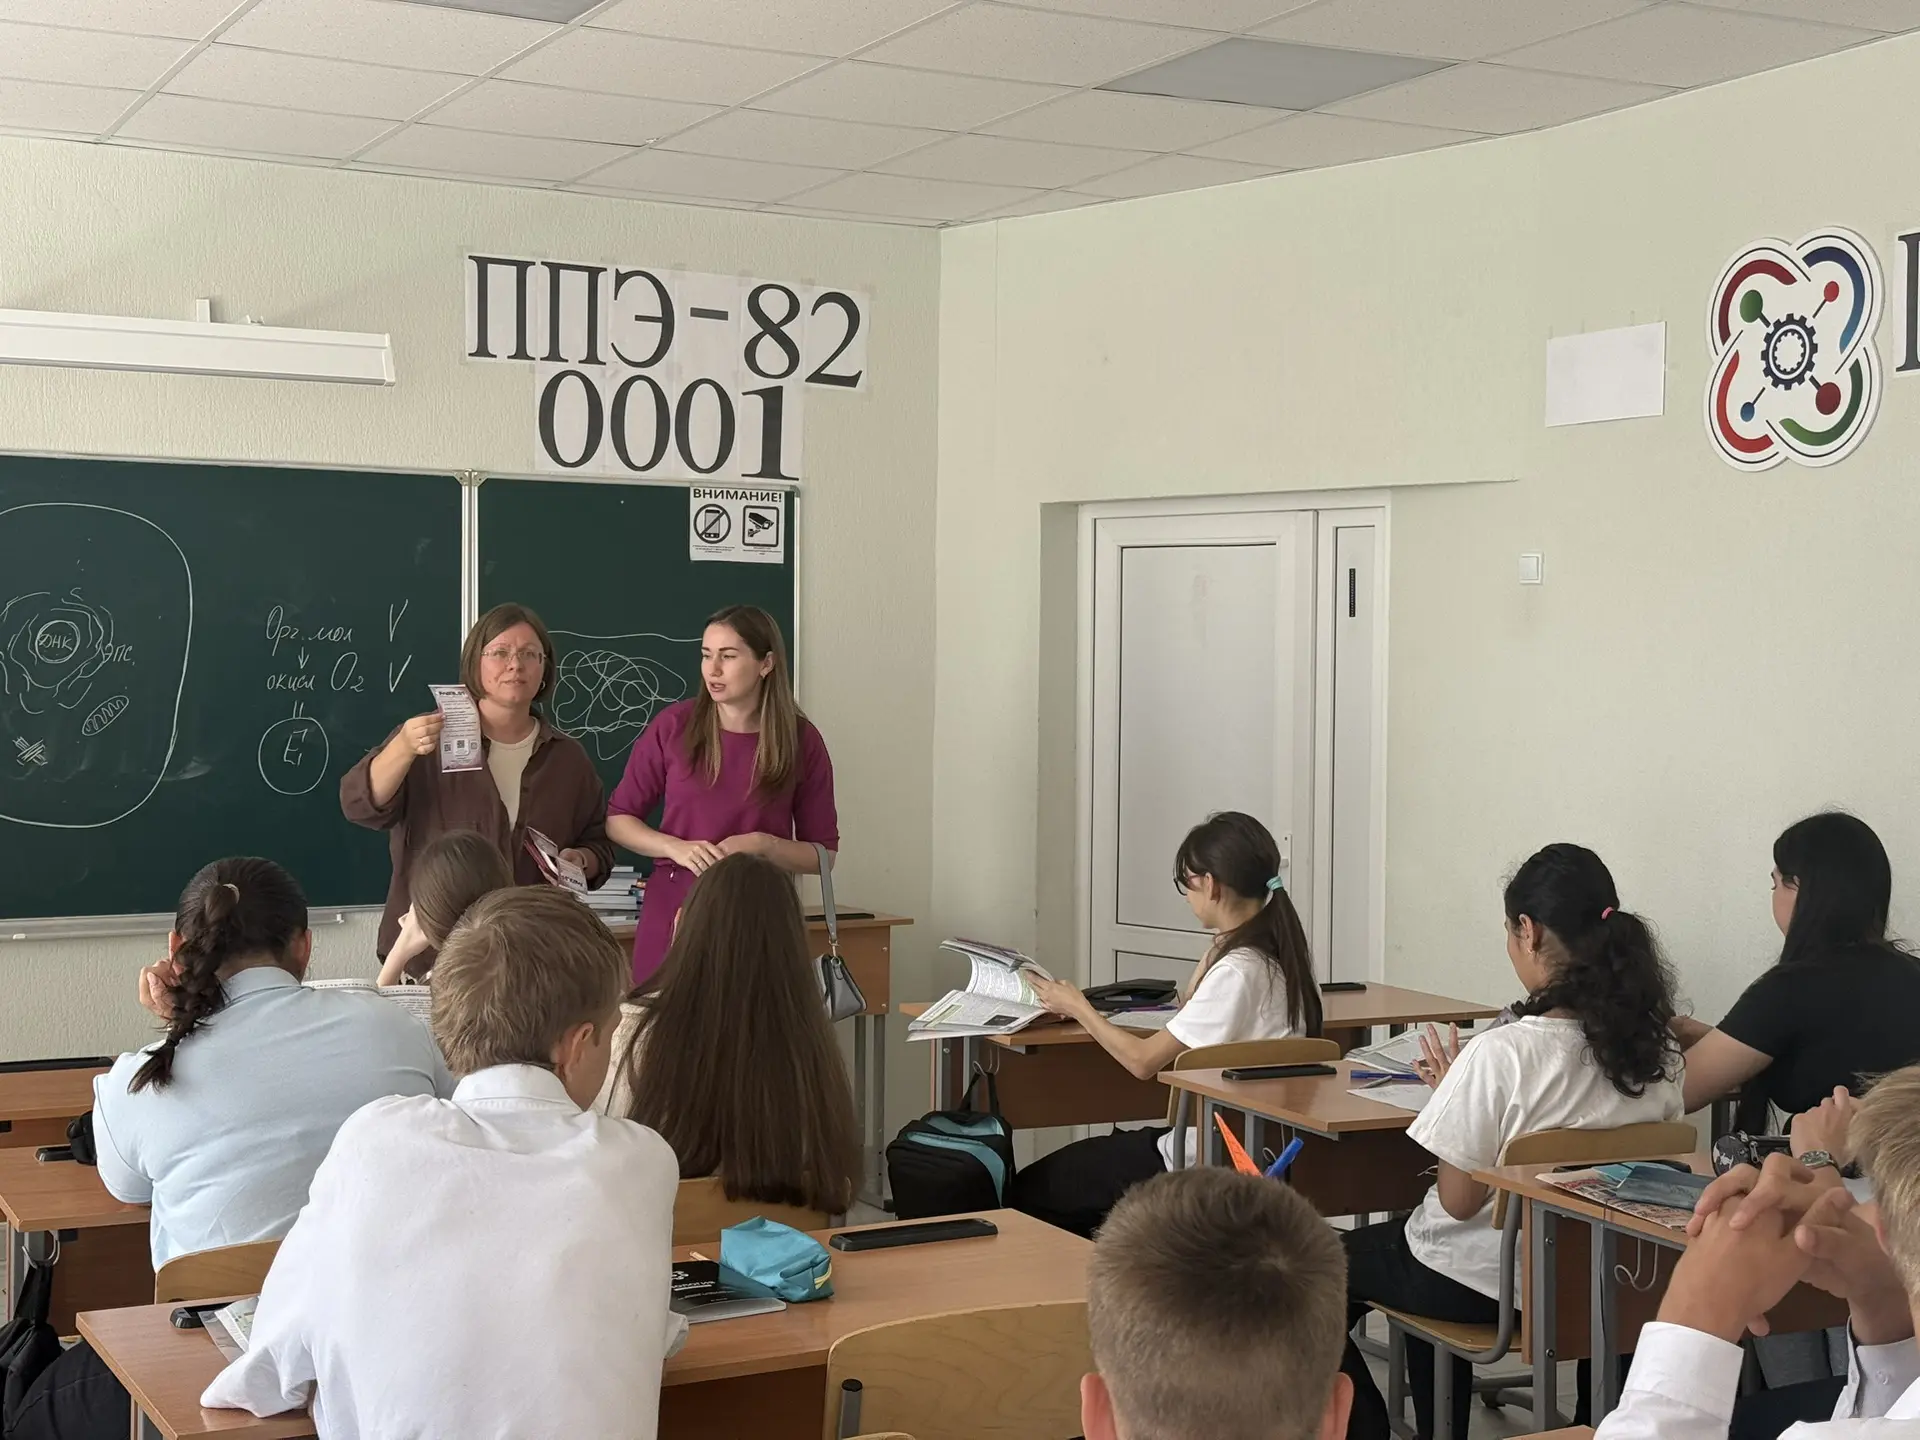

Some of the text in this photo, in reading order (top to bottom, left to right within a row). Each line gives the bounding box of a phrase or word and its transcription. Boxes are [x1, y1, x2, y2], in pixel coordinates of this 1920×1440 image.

[468, 255, 863, 388] ППЭ-82
[538, 370, 799, 481] 0001
[693, 488, 782, 503] ВНИМАНИЕ!
[38, 633, 73, 651] ДНК
